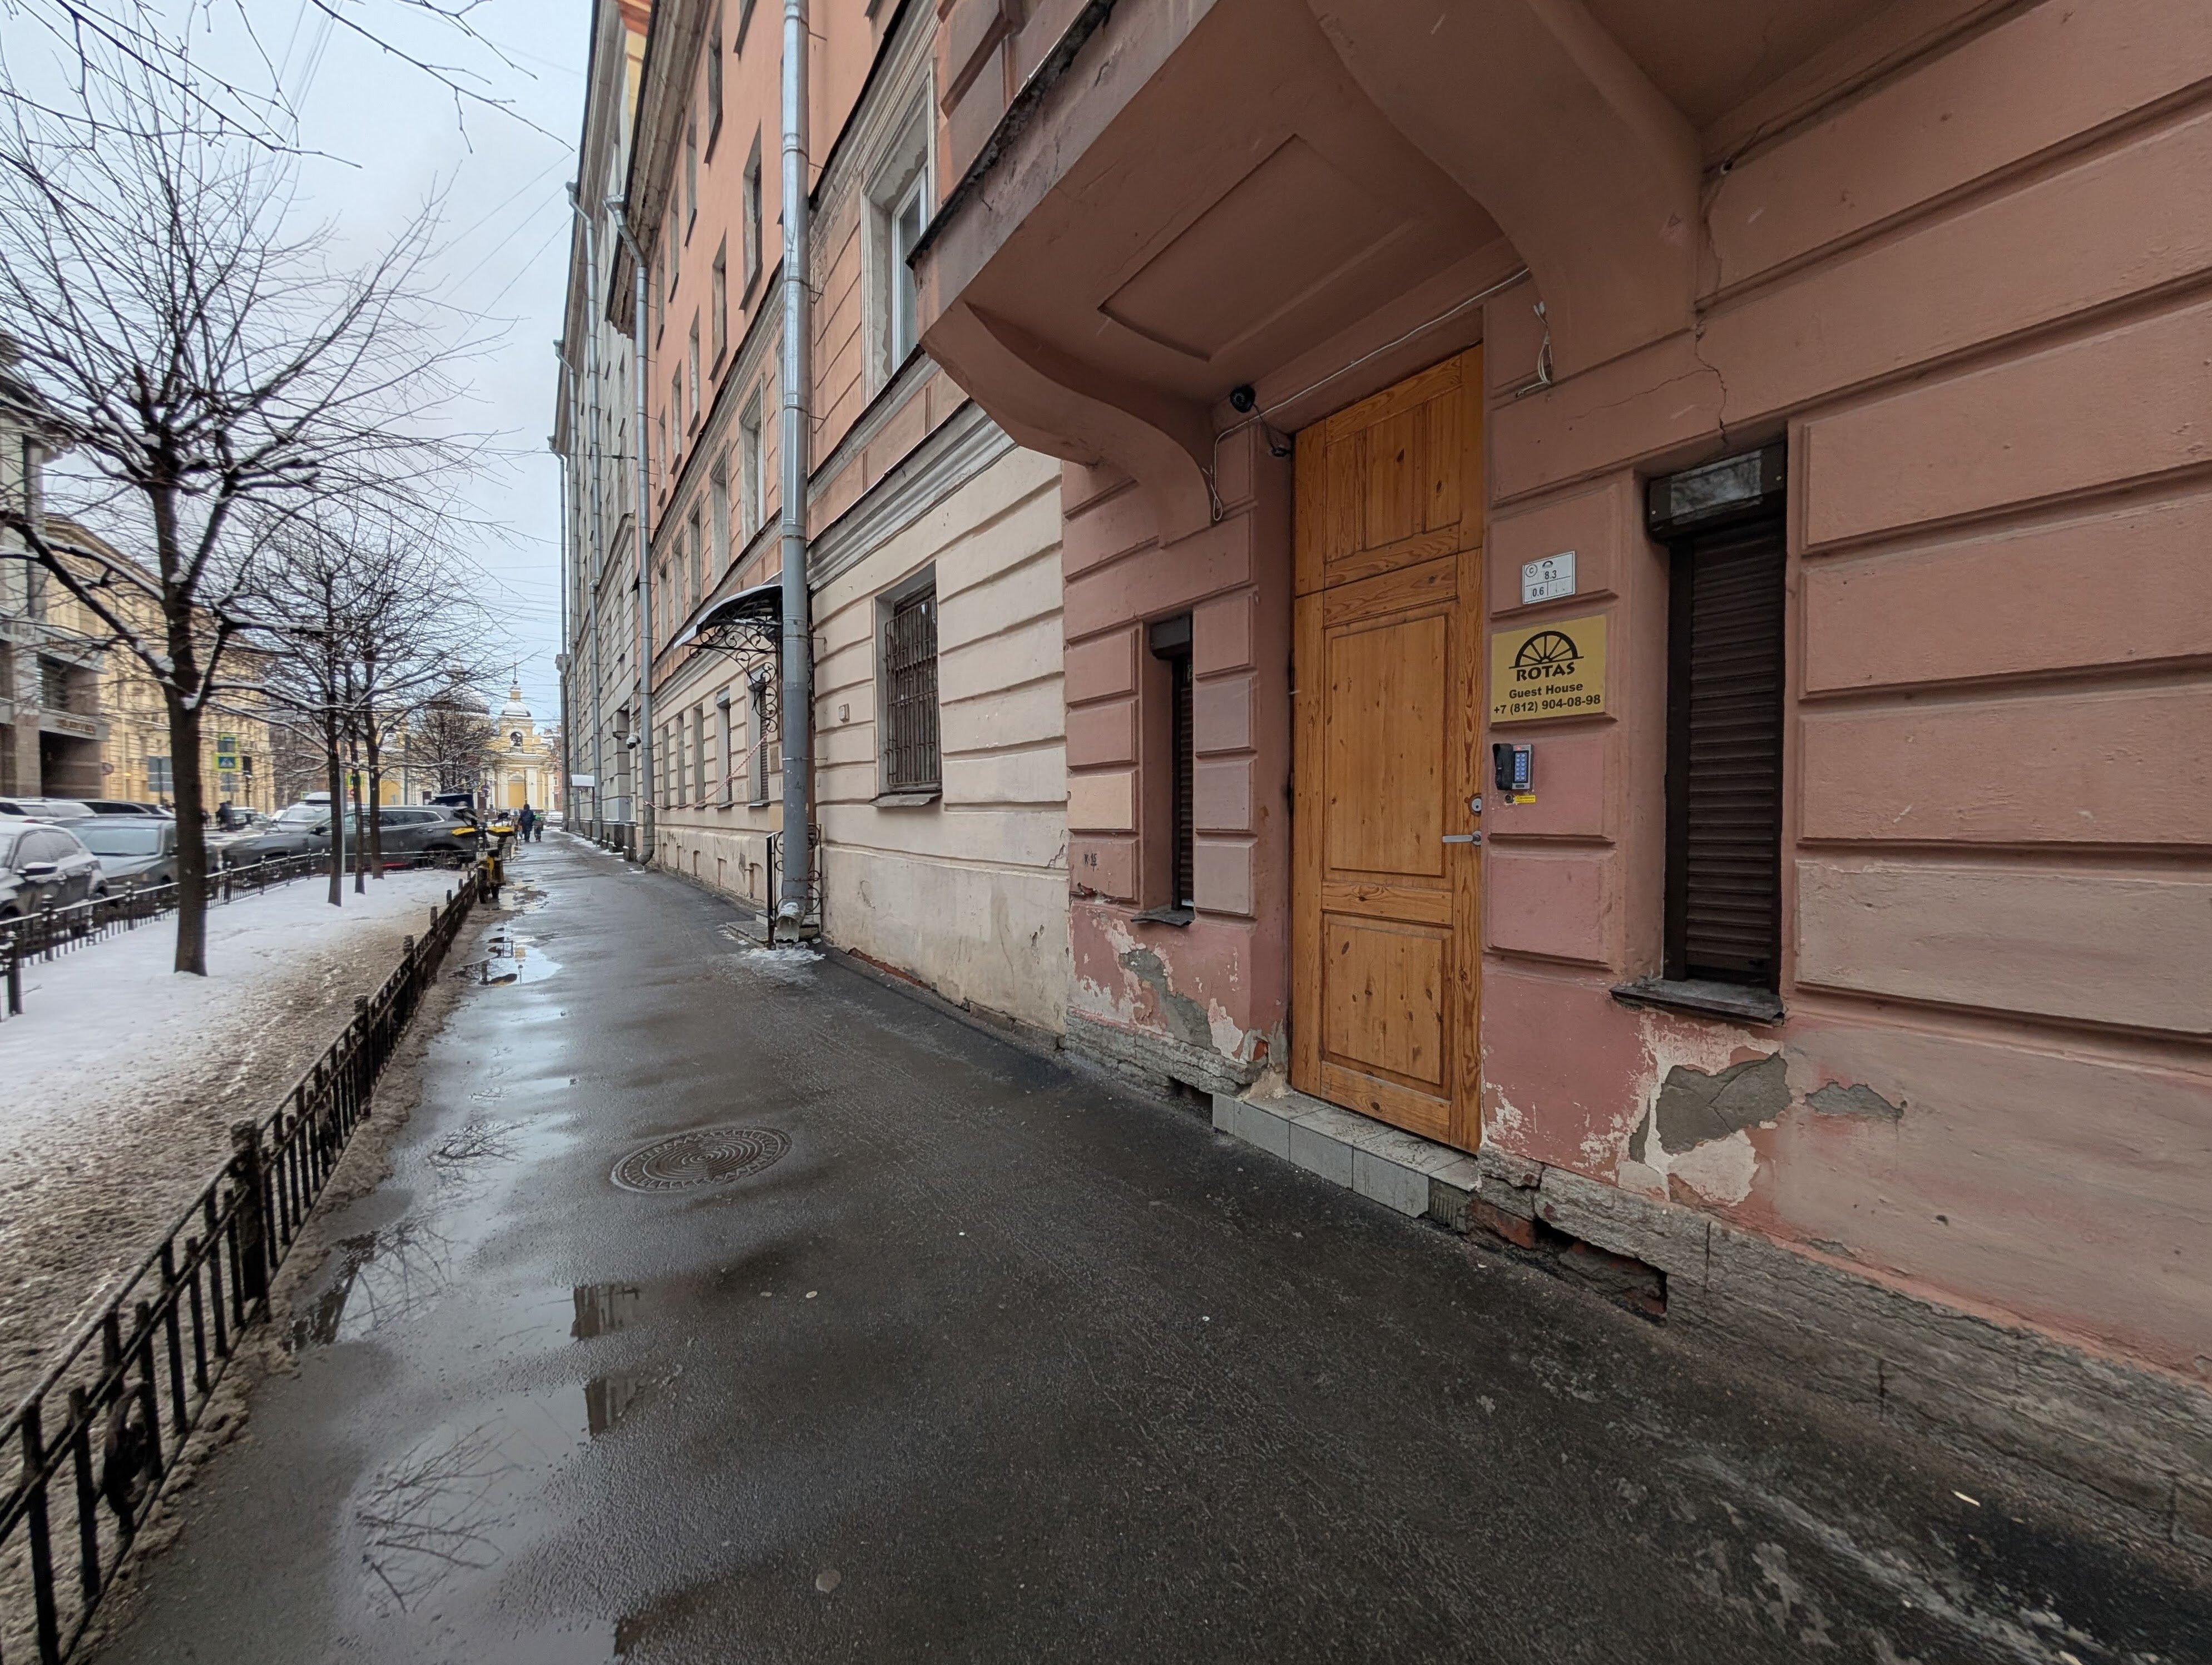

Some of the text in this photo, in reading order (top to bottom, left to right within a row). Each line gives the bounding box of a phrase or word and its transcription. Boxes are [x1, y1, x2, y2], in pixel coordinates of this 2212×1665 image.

[1545, 570, 1557, 579] 8.3
[1532, 587, 1544, 597] 0.6
[1516, 662, 1575, 681] ROTAS
[1509, 683, 1583, 698] Guest House
[1493, 694, 1601, 715] +7 (812) 904-08-98
